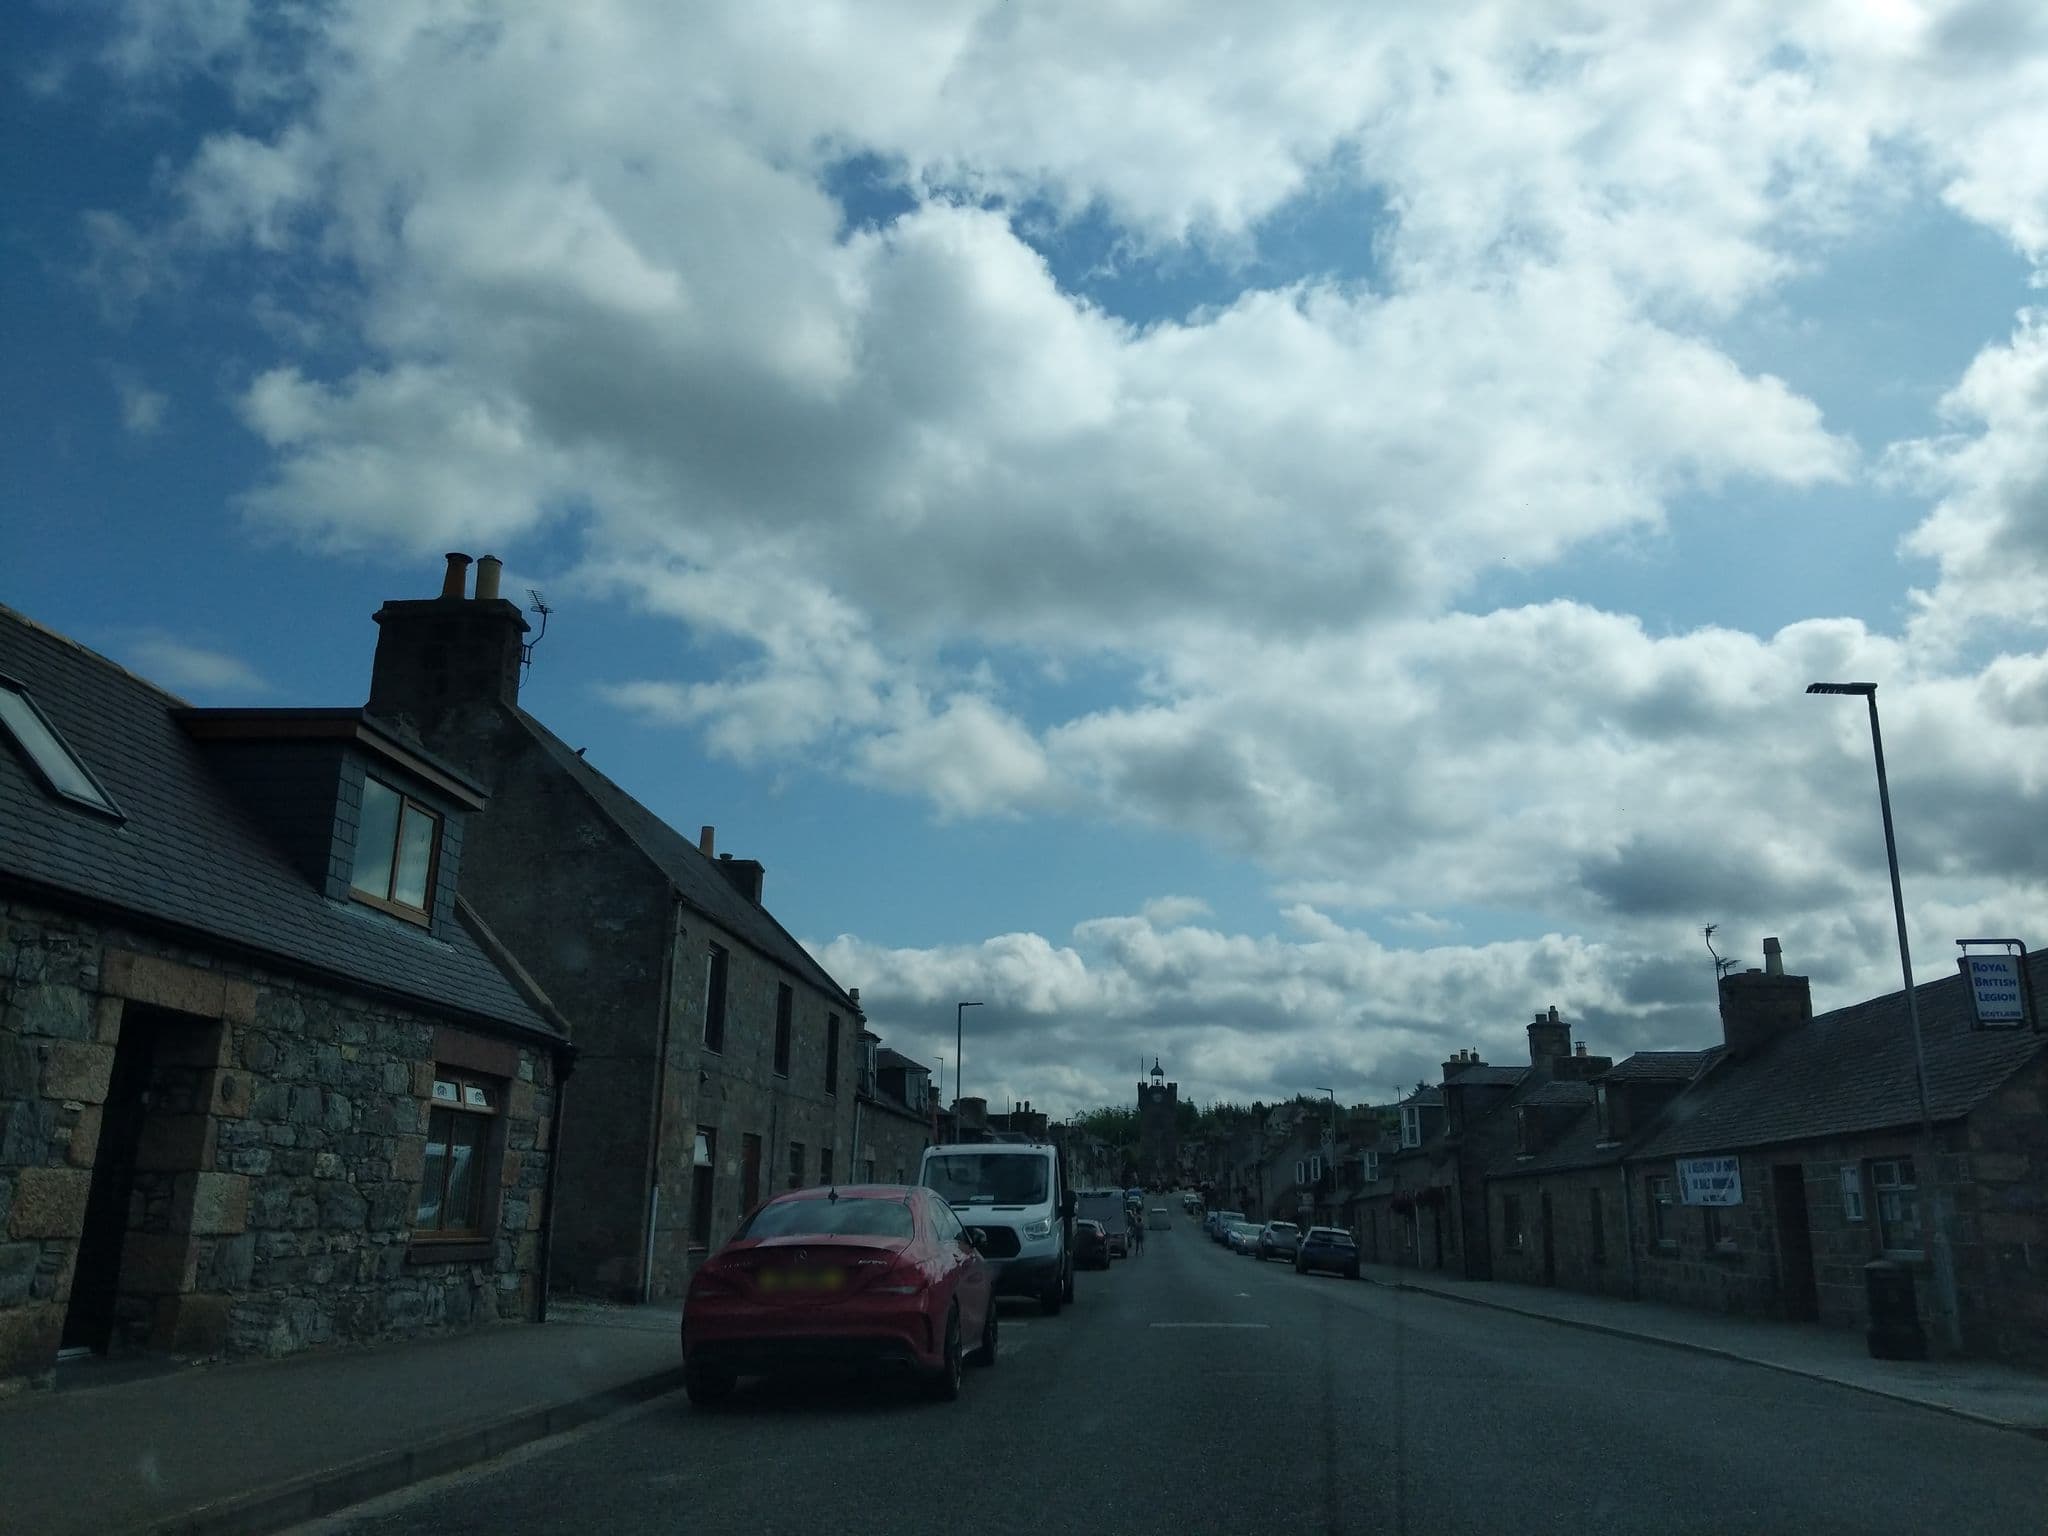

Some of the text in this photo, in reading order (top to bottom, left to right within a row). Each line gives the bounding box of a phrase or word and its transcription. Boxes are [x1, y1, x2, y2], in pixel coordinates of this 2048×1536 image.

[1972, 962, 2008, 973] ROYAL
[1975, 977, 2016, 987] BRITISH
[1978, 992, 2016, 1002] LEGION
